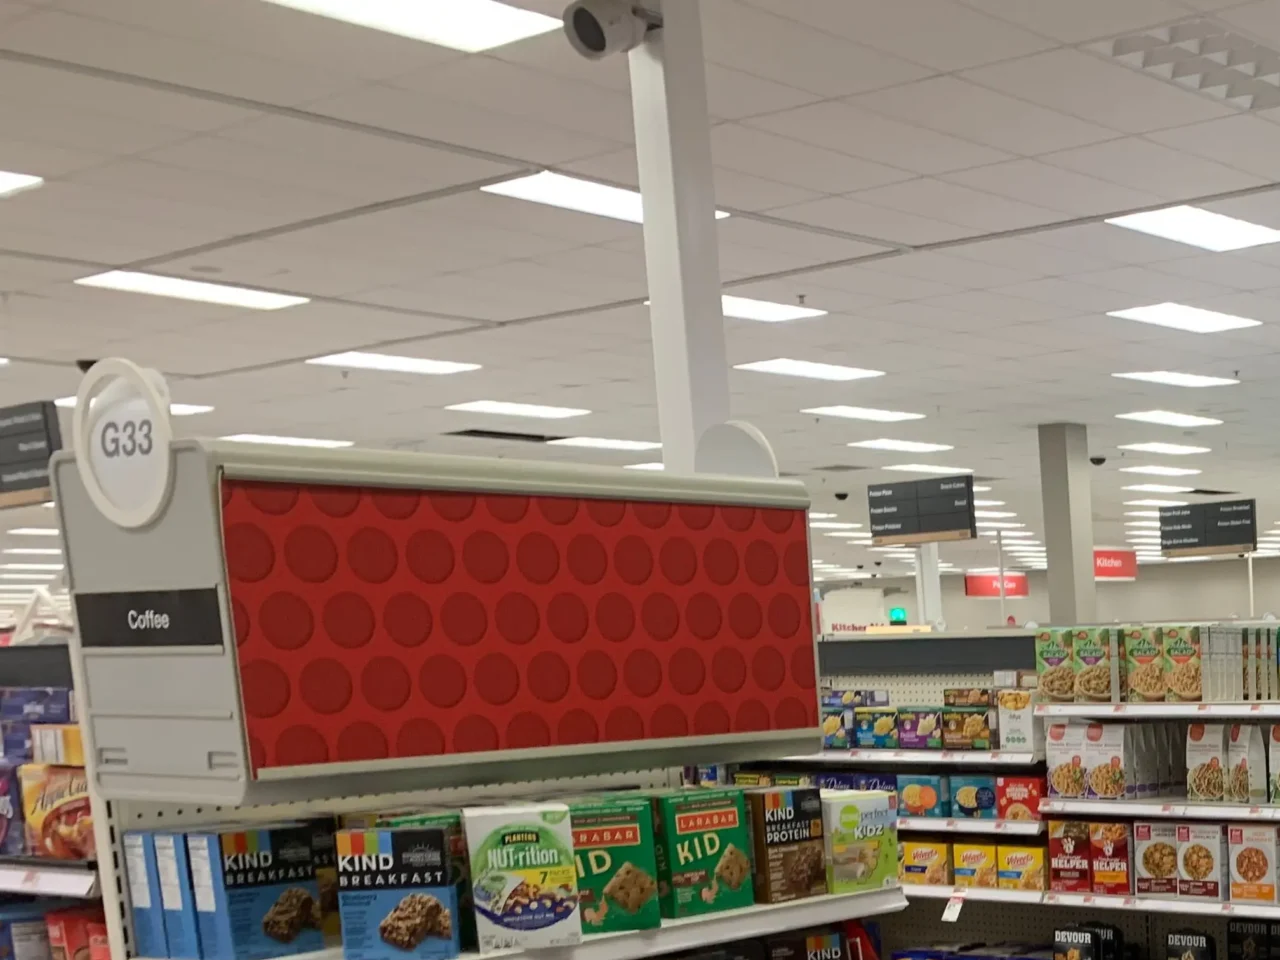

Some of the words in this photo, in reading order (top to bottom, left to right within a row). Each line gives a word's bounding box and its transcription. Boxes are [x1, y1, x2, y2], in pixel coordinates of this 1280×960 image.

[101, 419, 153, 458] G33
[1096, 557, 1122, 568] Kitchen
[128, 609, 170, 630] Coffee
[679, 811, 737, 830] LARABAR
[765, 807, 795, 823] KIND
[861, 808, 888, 823] perfect
[504, 832, 538, 844] PLANTERS
[572, 829, 635, 847] RABAR
[766, 827, 811, 844] PROTEIN
[854, 824, 884, 841] KIDZ
[676, 831, 721, 865] KID
[224, 853, 273, 872] KIND
[338, 853, 395, 872] KIND
[575, 849, 612, 879] ID
[1051, 858, 1089, 871] HELPER
[1092, 860, 1128, 873] HELPER
[225, 865, 314, 886] BREAKFAST
[339, 870, 444, 887] BREAKFAST
[539, 871, 548, 885] 7
[1055, 930, 1092, 945] DEVOUR
[1168, 934, 1207, 948] DEVOUR
[807, 947, 842, 960] KIND
